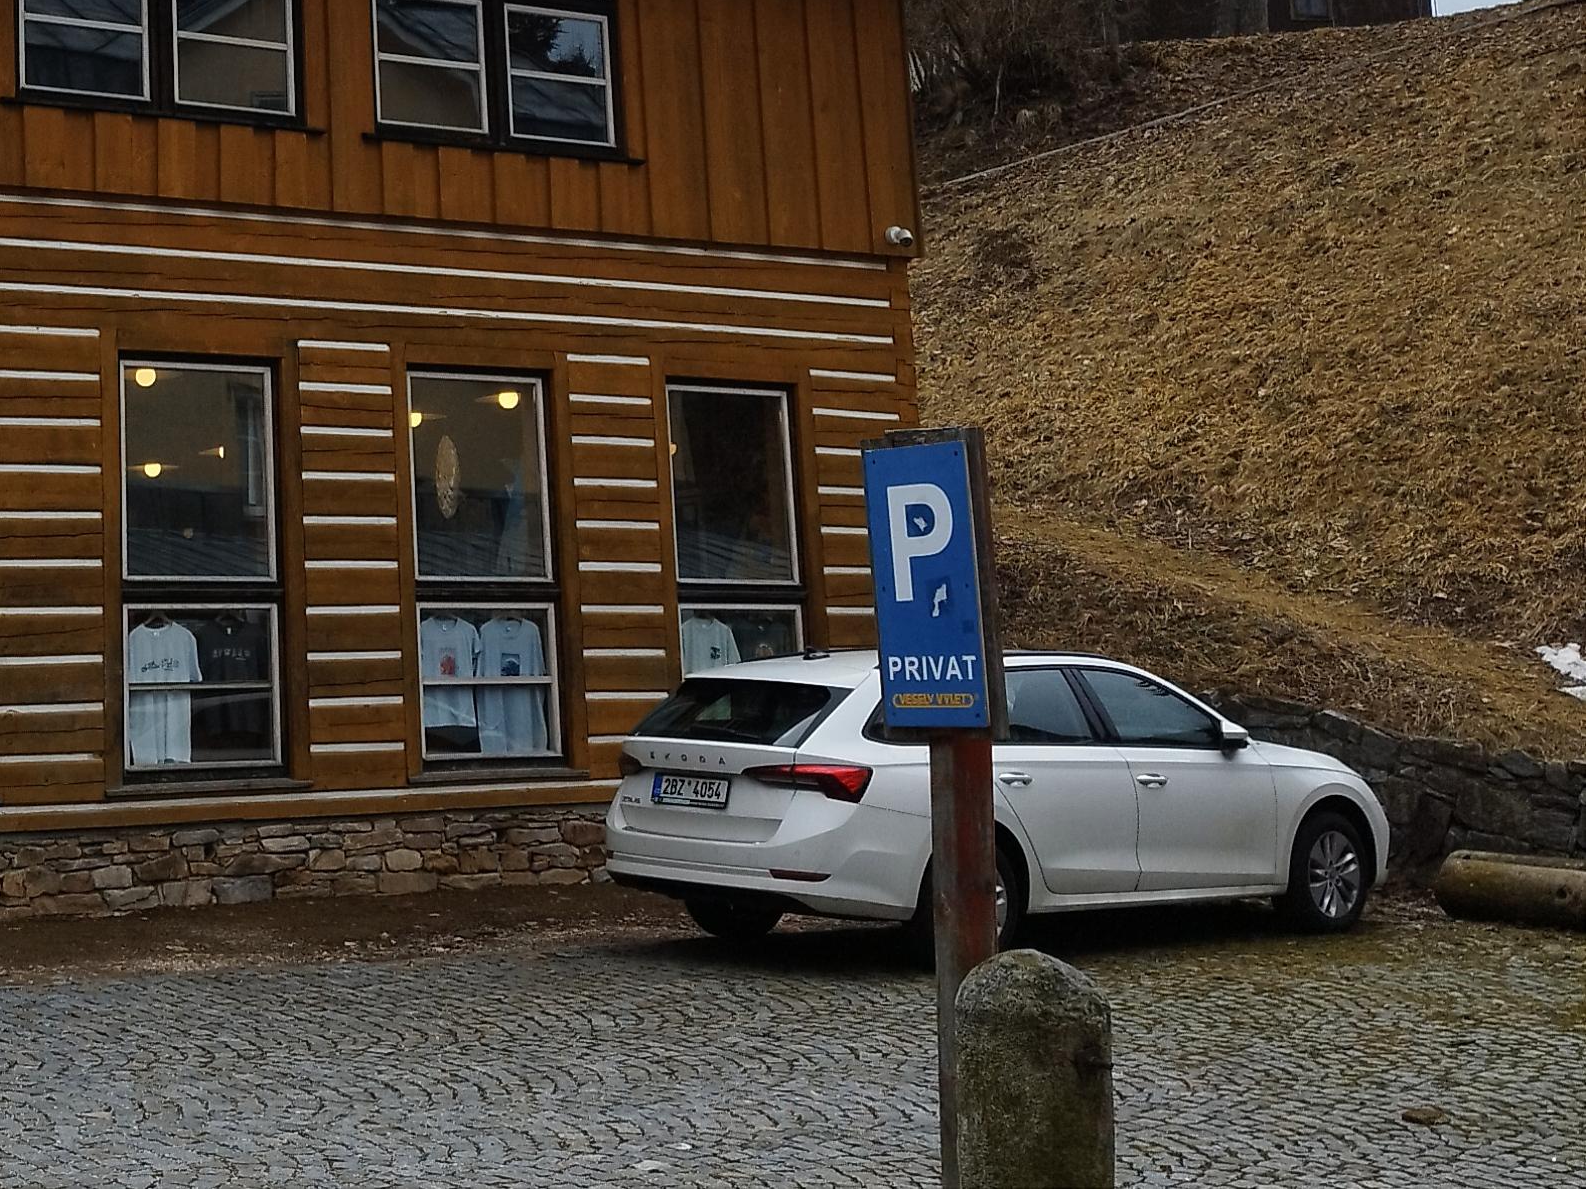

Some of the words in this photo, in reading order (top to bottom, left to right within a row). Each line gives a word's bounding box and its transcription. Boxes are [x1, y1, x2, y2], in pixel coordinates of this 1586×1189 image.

[887, 483, 955, 602] P
[888, 655, 976, 681] PRIVAT
[663, 777, 685, 796] 2BZ
[693, 780, 722, 800] 4054
